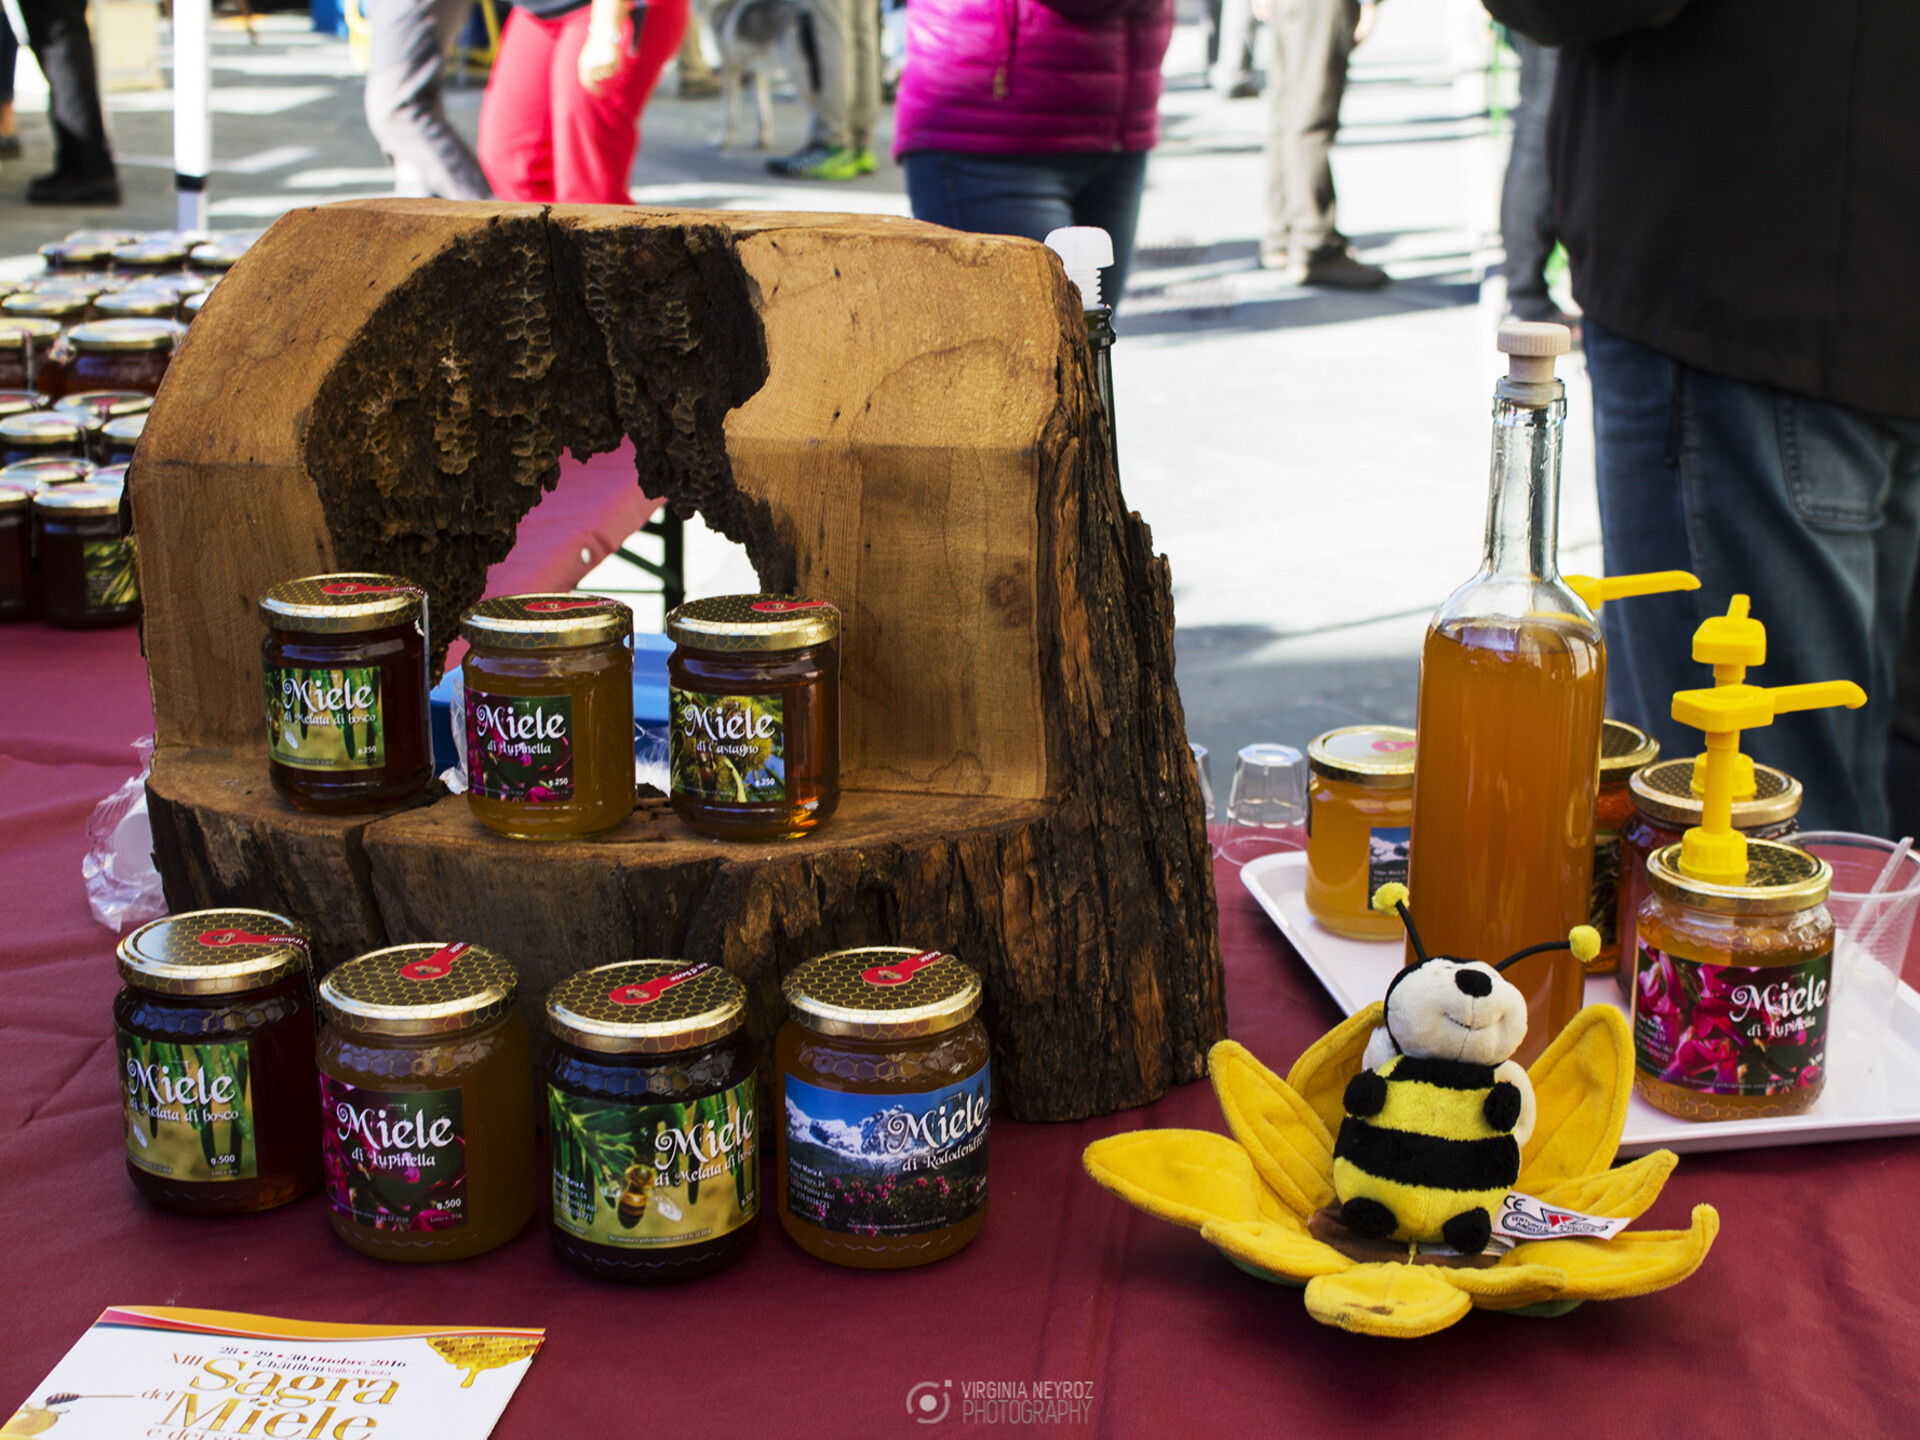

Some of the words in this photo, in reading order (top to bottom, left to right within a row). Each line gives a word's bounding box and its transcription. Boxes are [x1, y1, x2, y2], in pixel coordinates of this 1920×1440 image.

[282, 677, 374, 713] Miele
[284, 711, 293, 722] di
[295, 711, 330, 725] Melata
[333, 713, 345, 725] di
[348, 713, 376, 725] bosco
[476, 704, 567, 740] Miele
[684, 704, 776, 740] Miele
[487, 740, 497, 752] di
[499, 742, 552, 757] Lupinella
[696, 740, 706, 752] di
[708, 740, 759, 758] Castagno
[548, 777, 569, 787] g.250
[755, 777, 776, 788] g.250
[1729, 973, 1827, 1023] Miele
[1746, 1023, 1761, 1037] di
[126, 1057, 236, 1105] Miele
[130, 1096, 139, 1111] di
[140, 1102, 180, 1121] Melata
[184, 1108, 198, 1123] di
[202, 1108, 239, 1122] bosco
[336, 1102, 455, 1150] Miele
[886, 1093, 986, 1155] Miele
[654, 1106, 754, 1171] Miele
[210, 1153, 236, 1166] g.500
[351, 1147, 364, 1162] di
[367, 1149, 437, 1170] Lupinella
[902, 1157, 918, 1172] di
[653, 1171, 670, 1187] di
[674, 1162, 722, 1186] Melata
[725, 1154, 736, 1170] di
[436, 1198, 462, 1211] g.500
[165, 1353, 203, 1366] XIII
[218, 1346, 239, 1355] 28
[253, 1350, 273, 1358] 29
[287, 1353, 307, 1362] 30
[310, 1355, 366, 1366] Ottobre
[369, 1359, 407, 1368] 2016
[257, 1359, 325, 1373] Châtillon
[327, 1366, 351, 1375] Valle
[352, 1367, 392, 1377] d'Aosta
[189, 1356, 400, 1409] Sagra
[142, 1388, 175, 1401] del
[154, 1391, 377, 1440] Miele
